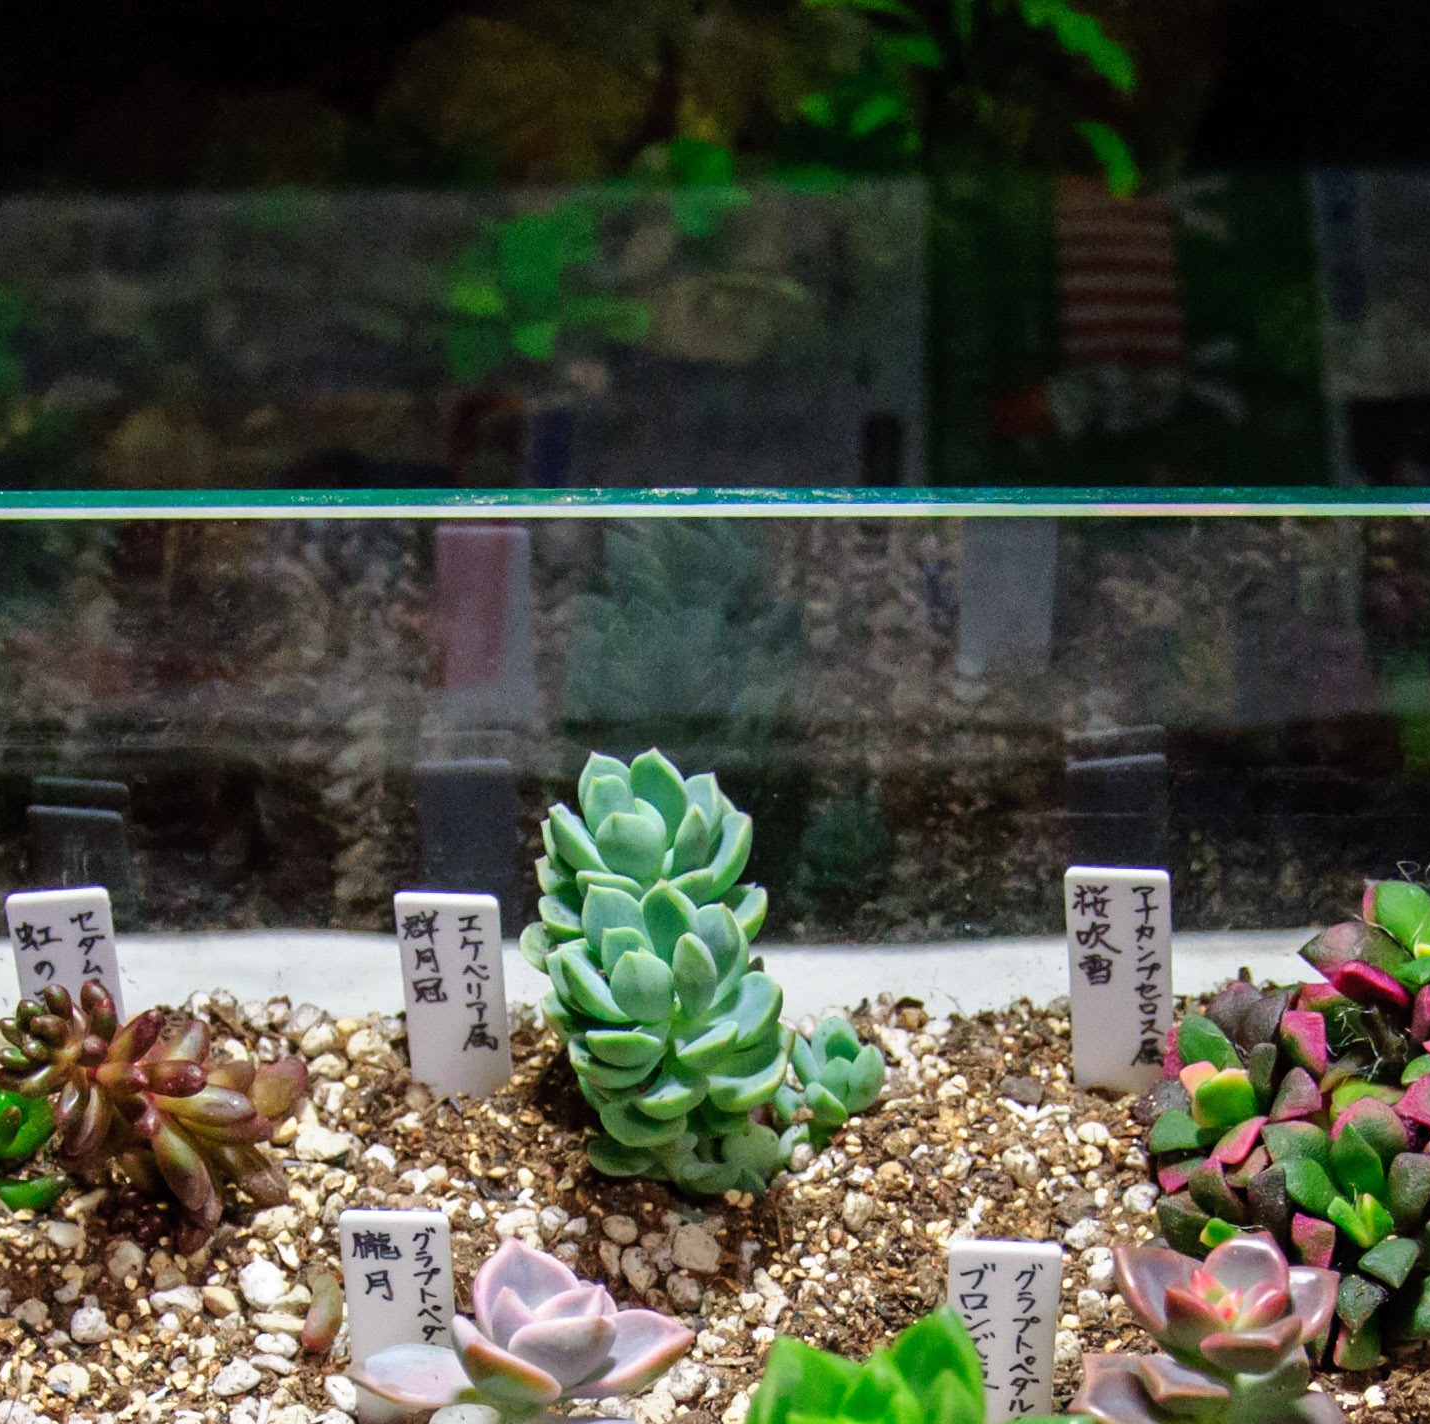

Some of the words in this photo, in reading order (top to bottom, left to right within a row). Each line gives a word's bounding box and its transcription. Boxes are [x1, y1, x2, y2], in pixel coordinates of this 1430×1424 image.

[14, 921, 63, 1004] 虹の
[68, 910, 106, 983] セダム
[457, 914, 499, 1051] エケベリア属
[1071, 884, 1123, 986] 桜吹雪
[351, 1229, 403, 1302] 朧月
[412, 1226, 447, 1345] グラプトペダ
[1008, 1263, 1044, 1421] グラプトペダル
